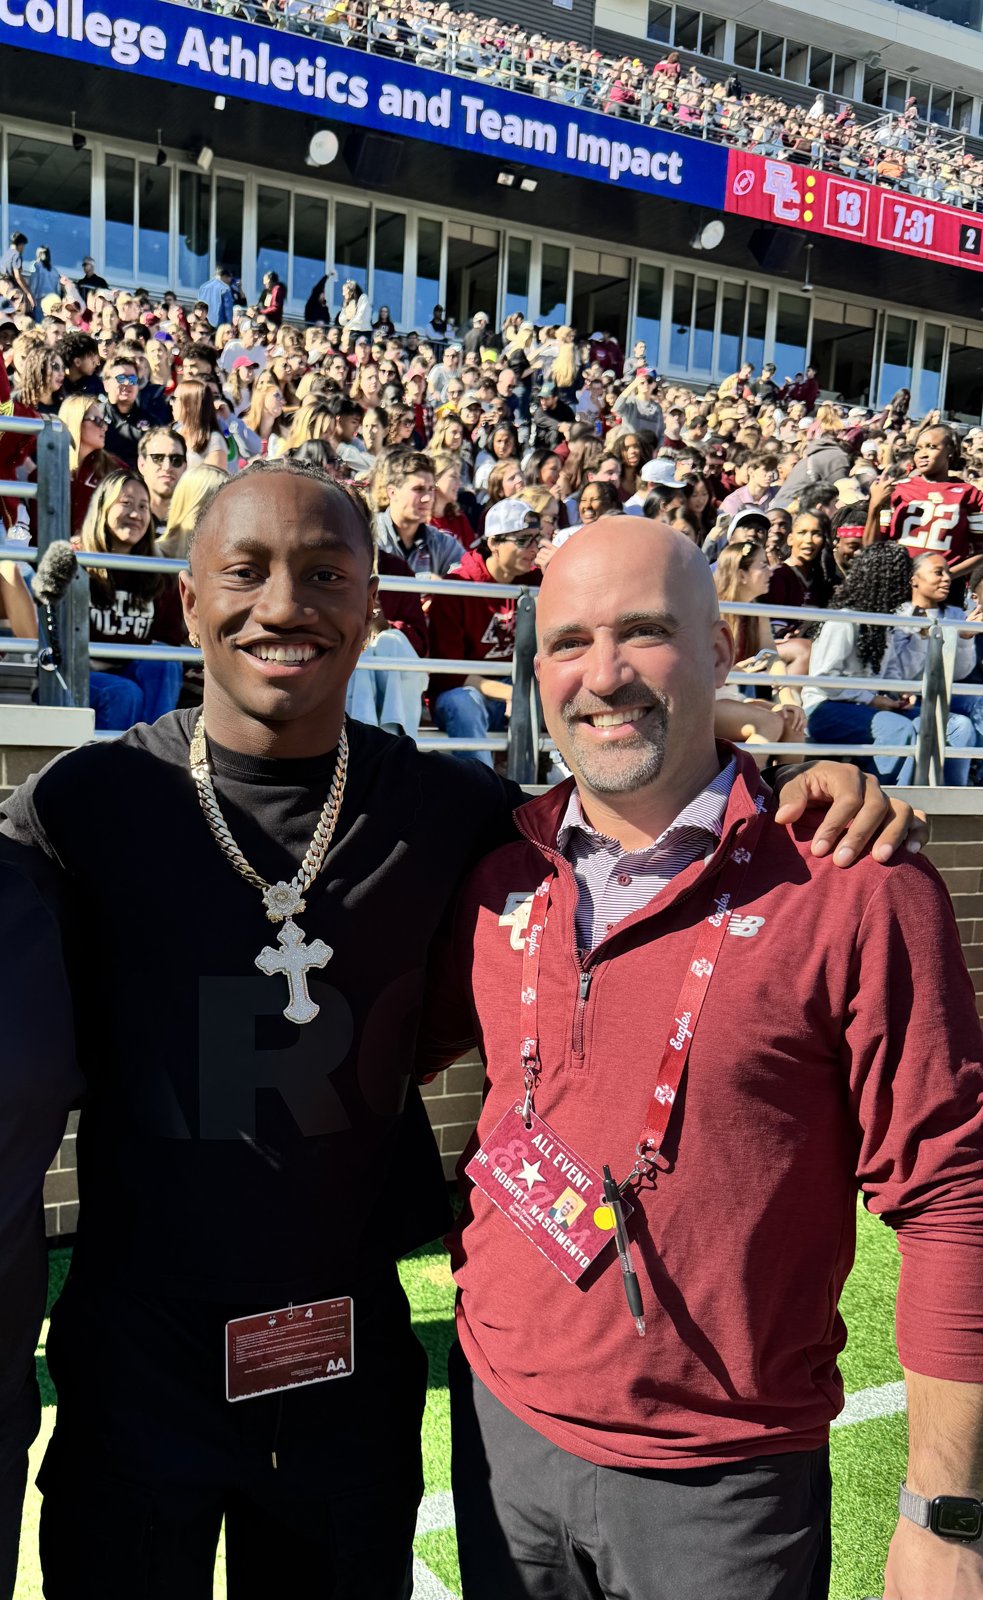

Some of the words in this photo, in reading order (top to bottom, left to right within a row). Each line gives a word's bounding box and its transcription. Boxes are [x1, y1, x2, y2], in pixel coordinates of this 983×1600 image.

[176, 27, 369, 109] Athletics
[378, 84, 452, 129] and
[461, 95, 557, 155] Team
[566, 122, 683, 185] Impact
[763, 160, 801, 221] BC
[836, 190, 861, 227] 13
[893, 204, 935, 246] 7:31
[964, 228, 977, 250] 2
[897, 500, 960, 551] 22
[707, 893, 732, 927] Eagles
[525, 924, 543, 956] Eagles
[669, 1011, 693, 1051] Eagles
[531, 1133, 552, 1159] ALL
[552, 1152, 593, 1193] EVENT
[474, 1148, 488, 1168] DR.
[492, 1166, 529, 1205] ROBERT
[529, 1204, 591, 1269] NASCIMENTO
[304, 1308, 313, 1318] 4
[326, 1357, 346, 1373] AA
